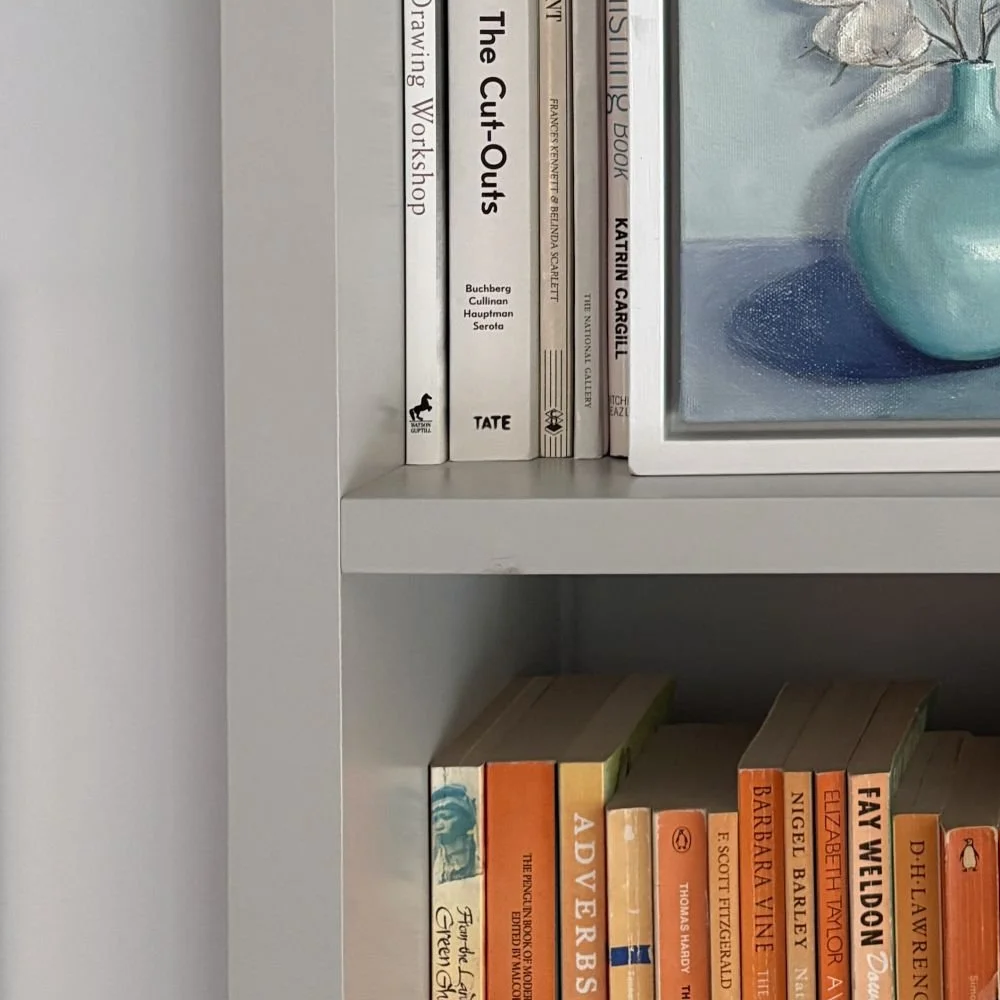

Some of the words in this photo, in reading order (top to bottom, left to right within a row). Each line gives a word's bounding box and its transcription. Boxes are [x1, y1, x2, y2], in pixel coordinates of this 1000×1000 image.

[480, 10, 506, 65] The
[481, 76, 508, 215] Cut-Outs
[550, 98, 560, 144] FRANCES
[407, 97, 435, 217] Workshop
[551, 206, 561, 249] BELINDA
[615, 217, 629, 282] KATRIN
[465, 284, 511, 294] Buchberg
[468, 296, 508, 305] Cullinan
[551, 251, 561, 303] SCARLETT
[463, 309, 514, 319] Hauptman
[473, 322, 504, 331] Serota
[584, 315, 593, 363] NATIONAL
[473, 415, 511, 430] TATE
[791, 791, 805, 857] NIGEL
[858, 786, 882, 831] FAY
[753, 786, 773, 888] BARBARA
[824, 790, 841, 891] ELIZABETH
[718, 846, 730, 892] SCOTT
[859, 837, 884, 947] WELDON
[522, 874, 533, 917] PENGUIN
[574, 812, 598, 994] ADVERBS
[680, 883, 690, 930] THOMAS
[793, 867, 808, 949] BARLEY
[436, 906, 454, 967] Green
[511, 911, 521, 946] EDITED
[523, 919, 533, 948] BOOK
[719, 897, 733, 989] FITZGERALD
[755, 896, 774, 953] VINE
[827, 895, 843, 966] TAYLOR
[680, 935, 690, 974] HARDY
